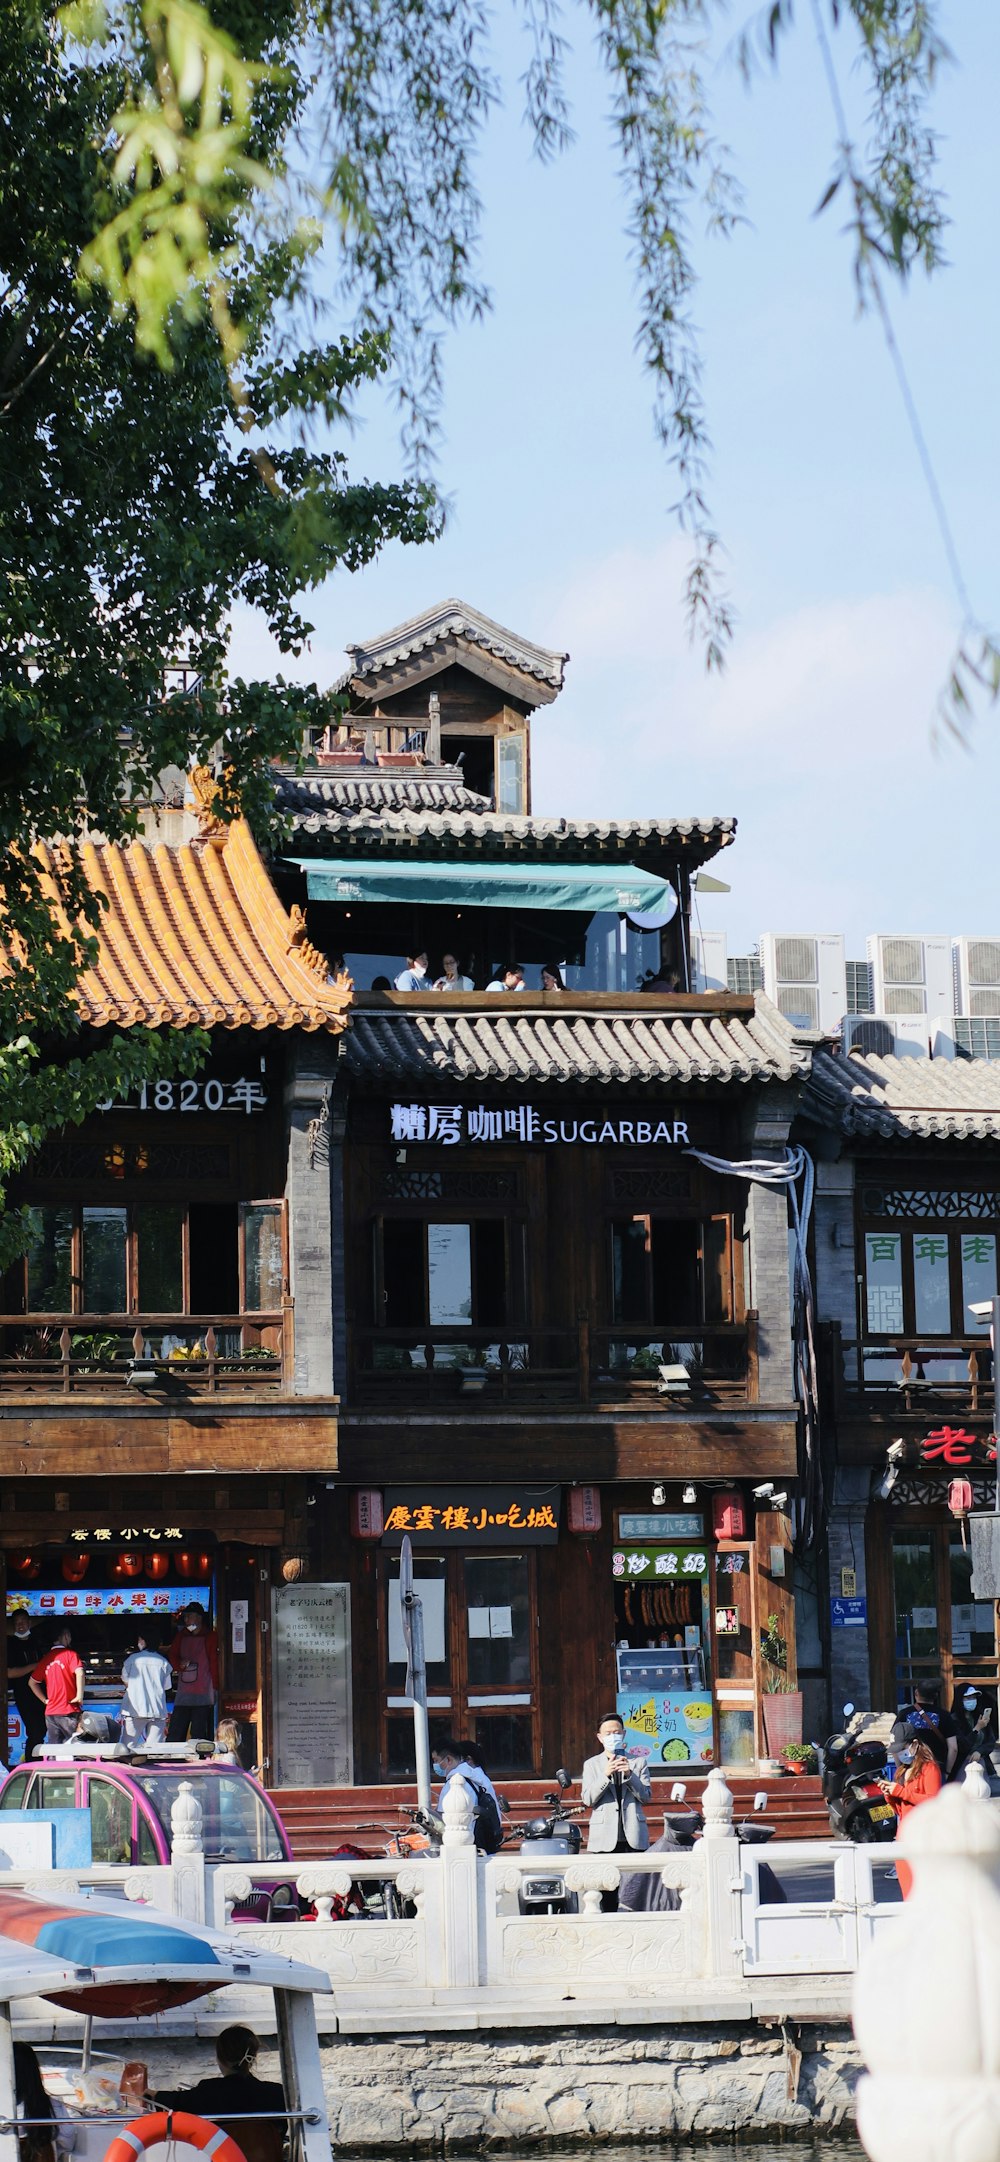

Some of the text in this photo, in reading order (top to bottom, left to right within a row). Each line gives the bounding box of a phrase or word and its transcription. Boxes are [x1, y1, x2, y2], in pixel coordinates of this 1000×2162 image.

[543, 1120, 690, 1144] SUGARBAR
[384, 1503, 558, 1531] 慶雲樓小吃城
[626, 1552, 707, 1575] 炒酸奶
